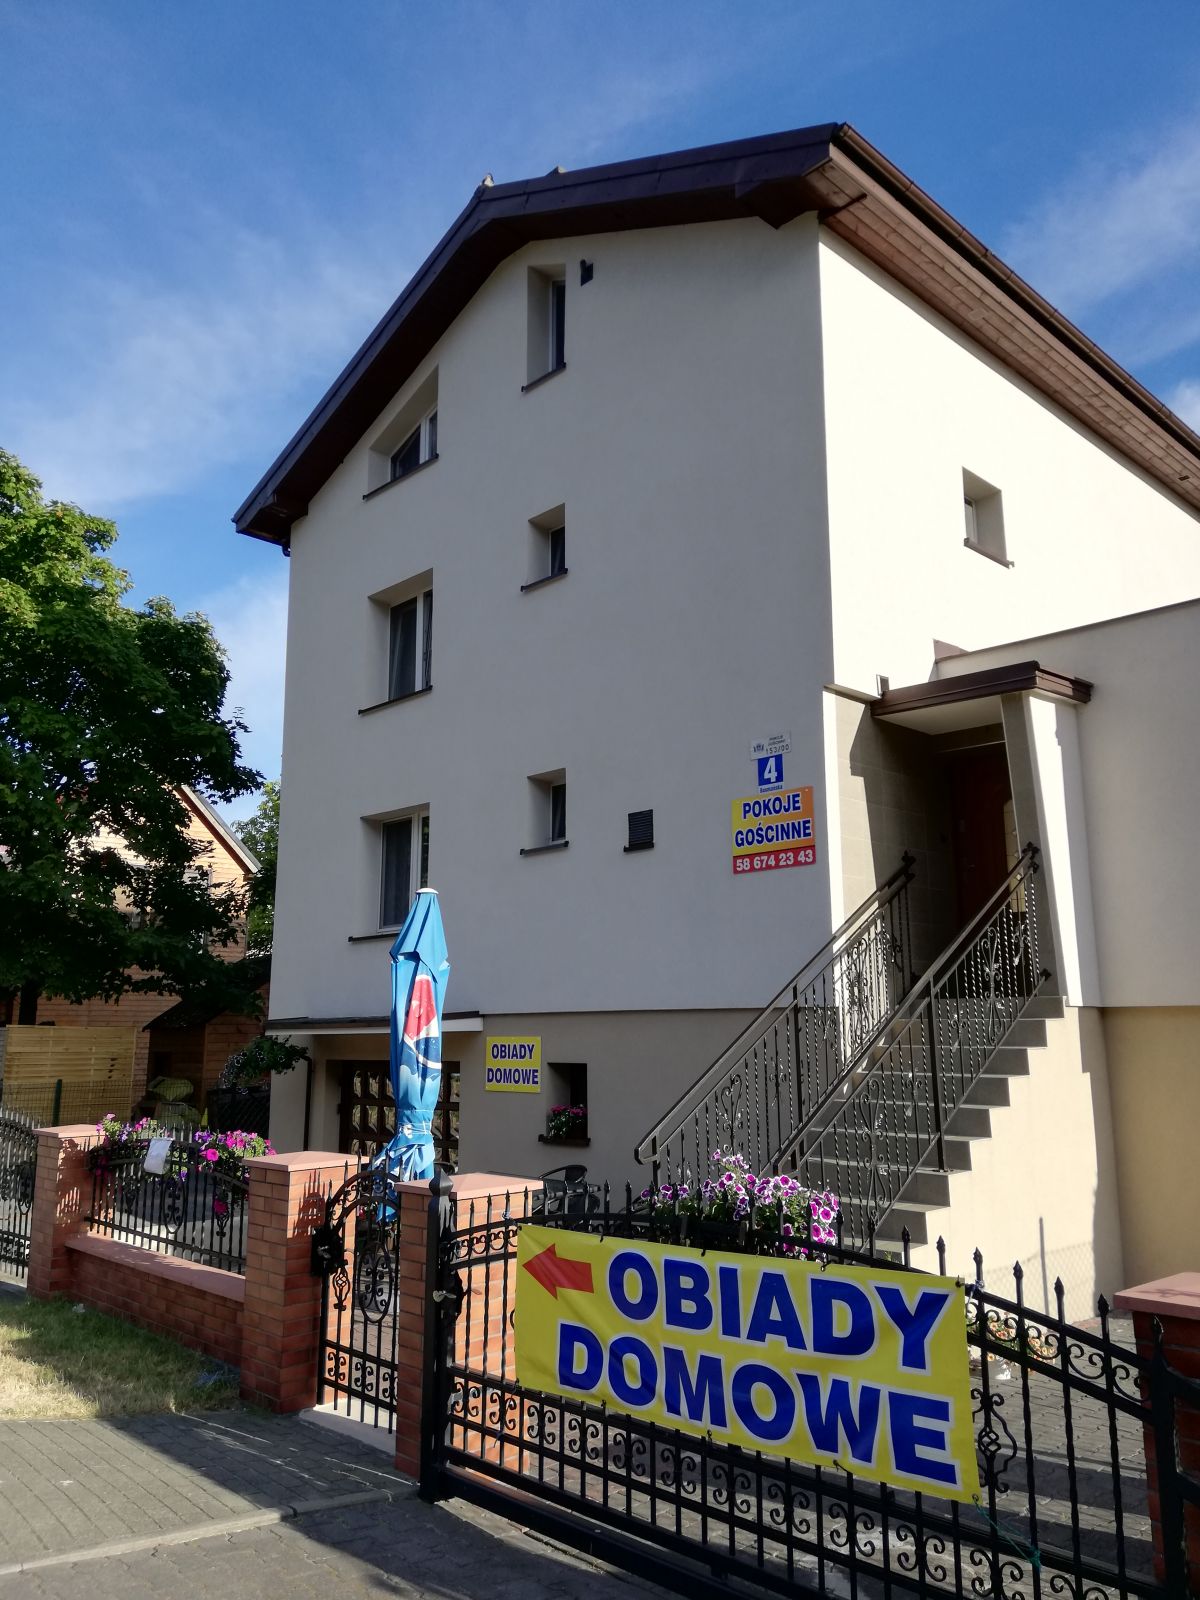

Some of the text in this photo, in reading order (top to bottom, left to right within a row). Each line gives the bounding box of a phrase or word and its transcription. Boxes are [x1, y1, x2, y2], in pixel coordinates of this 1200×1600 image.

[763, 757, 778, 782] 4
[743, 793, 801, 819] POKOJE
[735, 819, 812, 848] GOŚCINNE
[736, 849, 813, 871] 58 674 23 43
[491, 1043, 535, 1060] OBIADY
[486, 1067, 539, 1085] DOMOWE
[606, 1249, 951, 1372] OBIADY
[557, 1321, 959, 1487] DOMOWE
